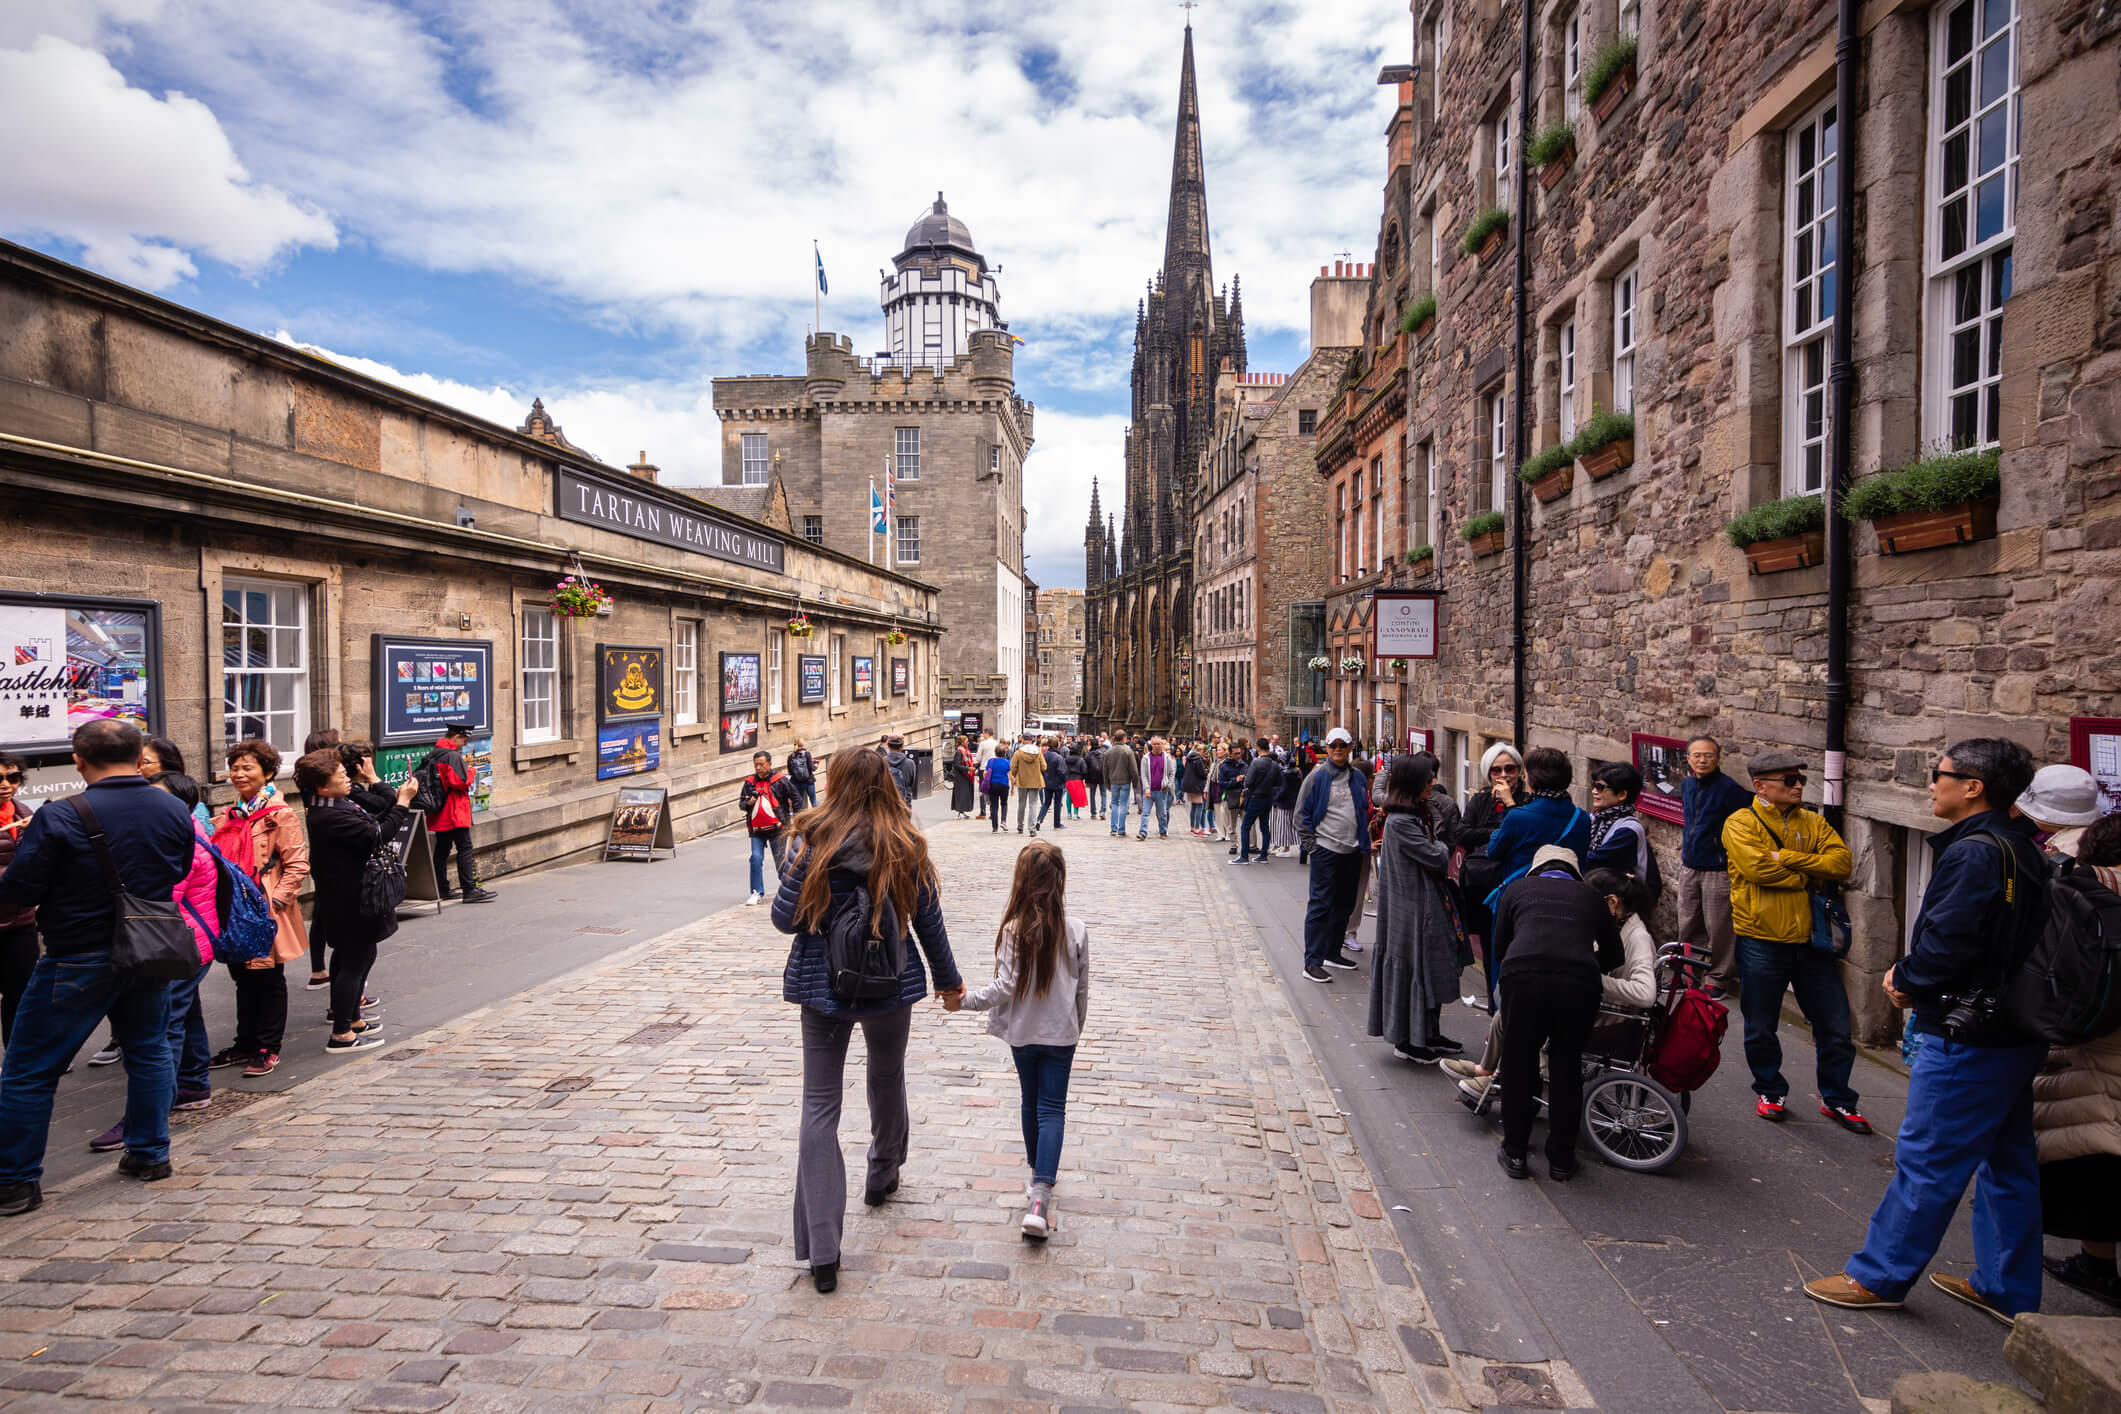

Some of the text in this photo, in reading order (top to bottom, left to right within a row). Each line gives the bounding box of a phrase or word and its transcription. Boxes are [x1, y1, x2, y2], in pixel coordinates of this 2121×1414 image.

[577, 484, 775, 565] TARTAN WEAVING MILL
[2005, 878, 2013, 903] Nikon
